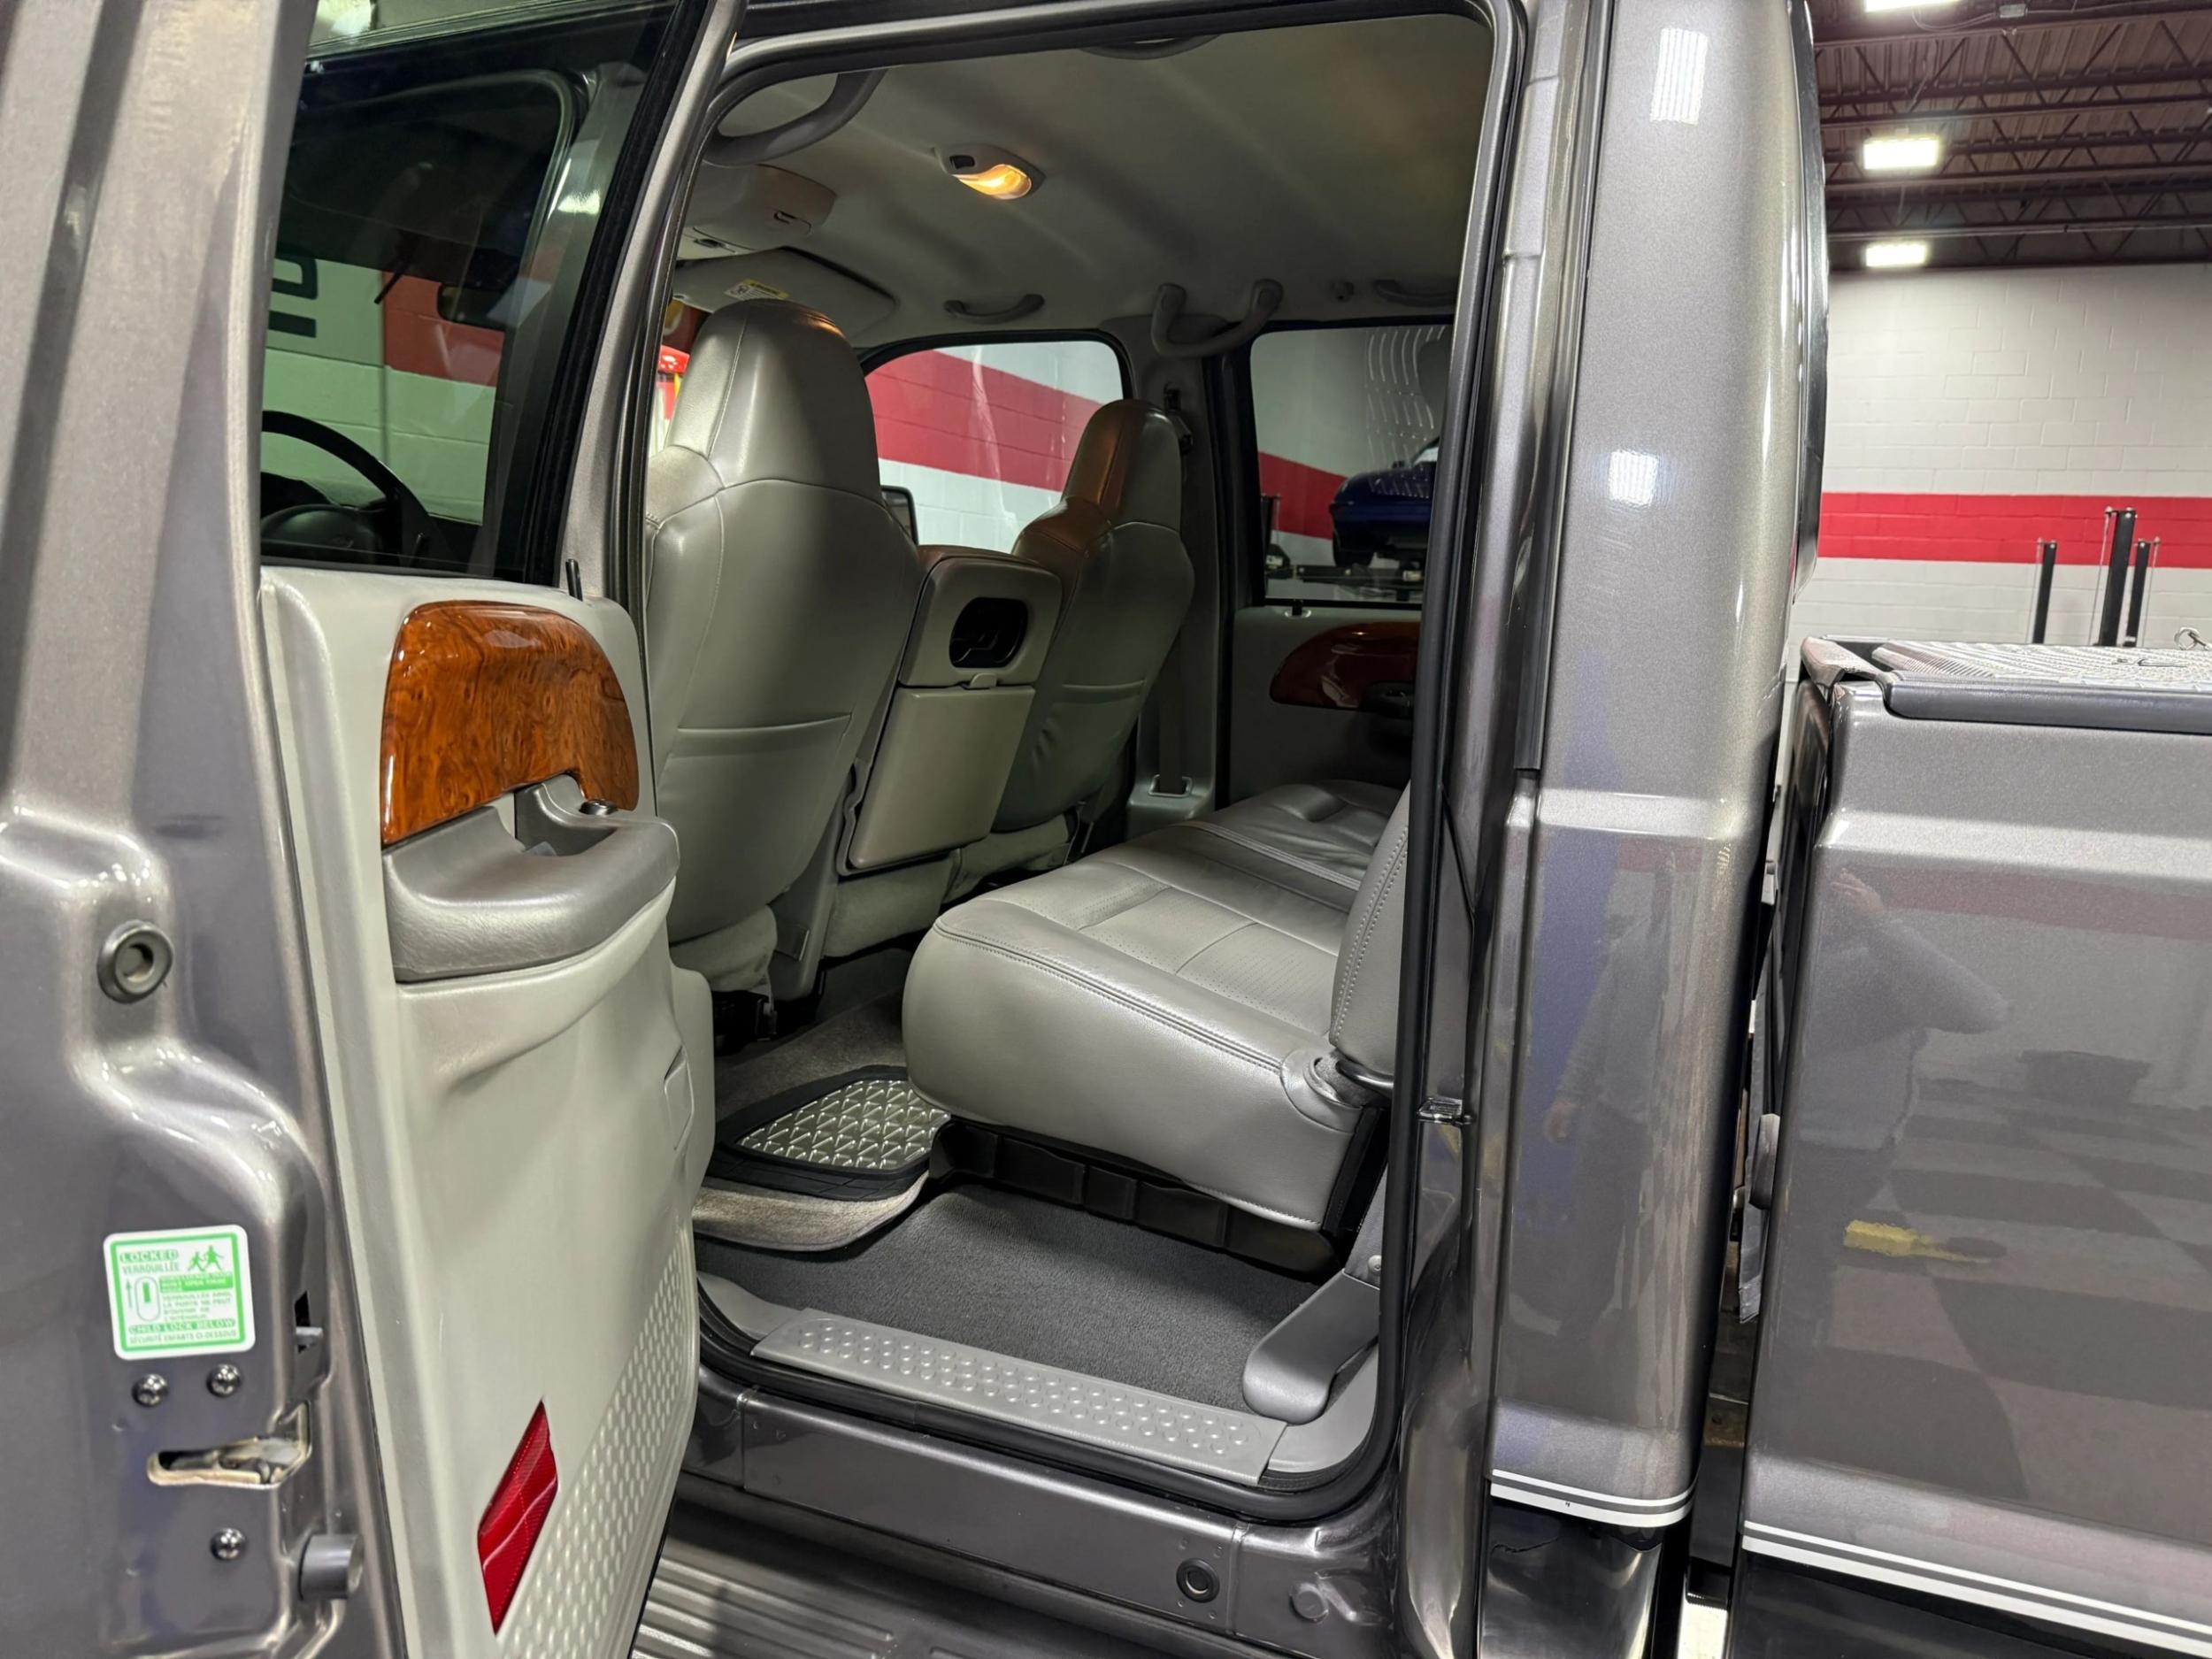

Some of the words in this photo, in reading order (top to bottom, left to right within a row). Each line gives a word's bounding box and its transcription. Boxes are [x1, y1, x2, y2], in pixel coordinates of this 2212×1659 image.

[121, 1249, 178, 1263] LOCKED
[129, 1323, 161, 1334] CHILD
[164, 1321, 192, 1333] LOCK
[199, 1318, 235, 1331] BELOW
